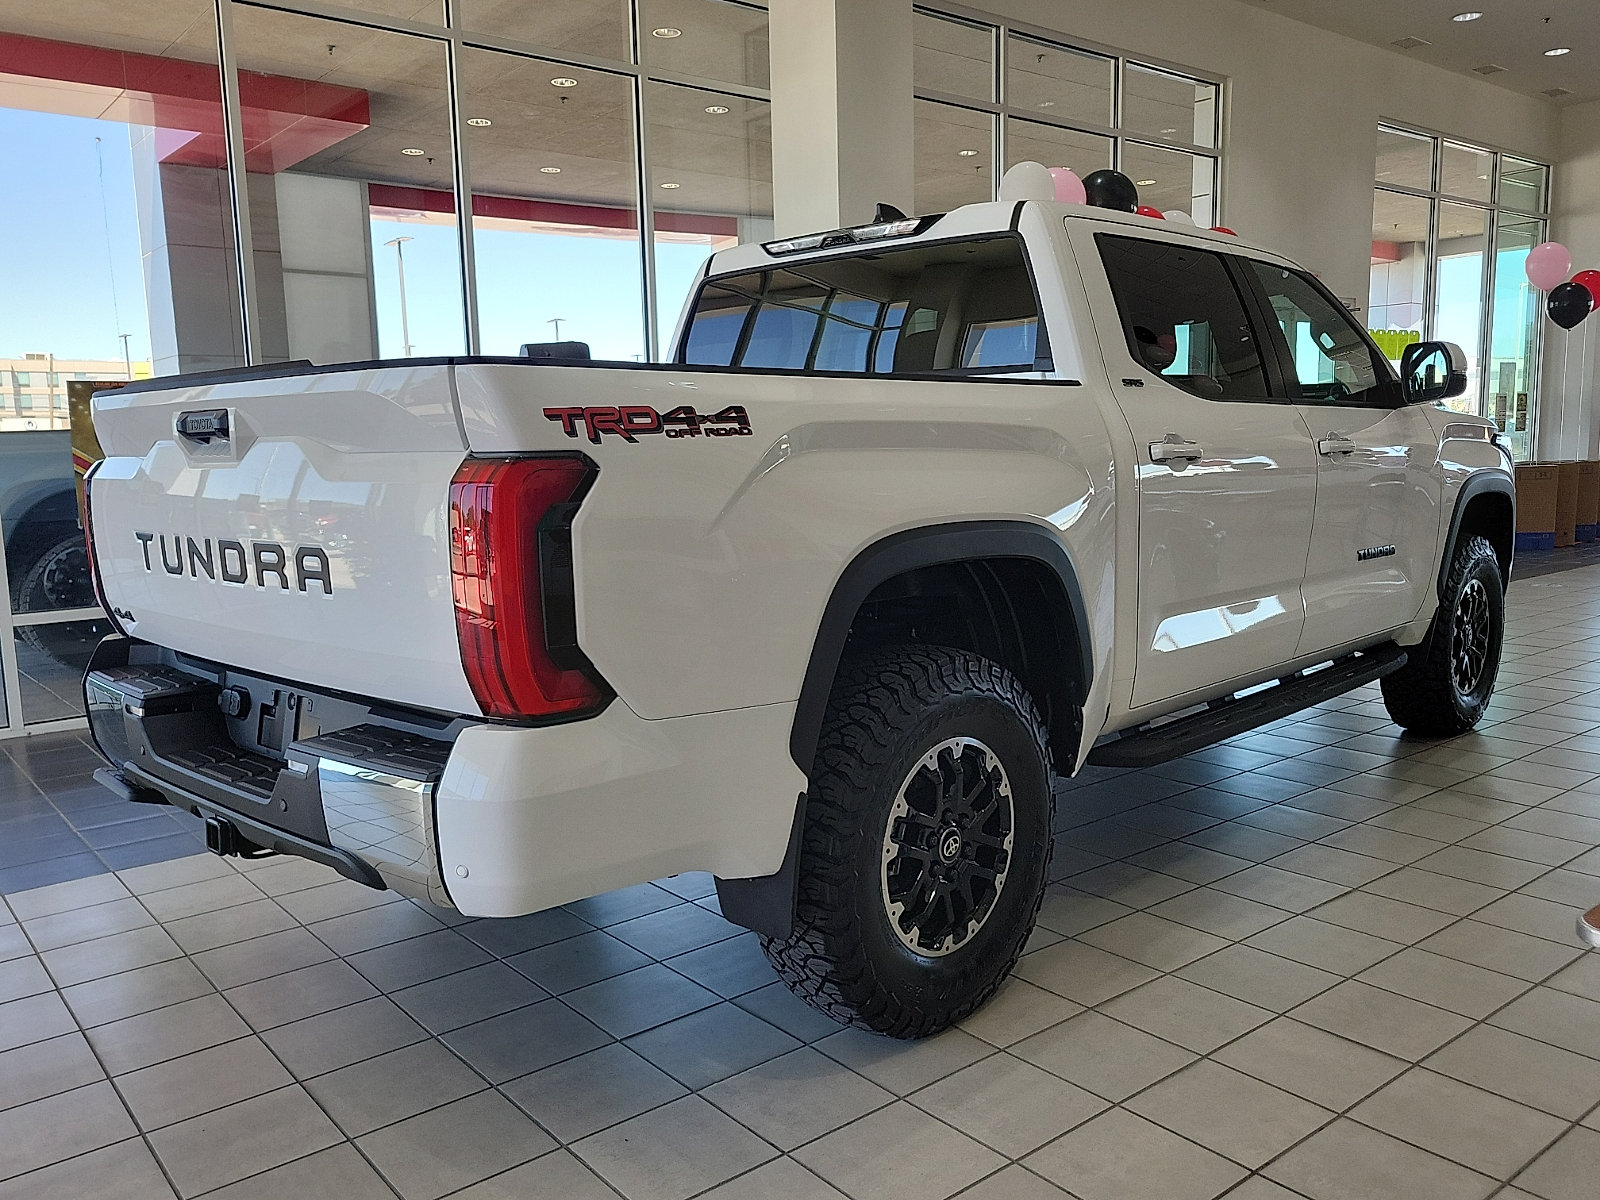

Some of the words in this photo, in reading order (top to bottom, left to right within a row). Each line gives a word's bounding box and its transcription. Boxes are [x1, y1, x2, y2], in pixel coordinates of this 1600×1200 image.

[189, 418, 214, 431] TOYOTA
[543, 405, 664, 444] TRD
[665, 428, 702, 438] OFF
[704, 427, 753, 437] ROAD
[1357, 544, 1396, 561] TUNDRA
[135, 531, 333, 595] TUNDRA
